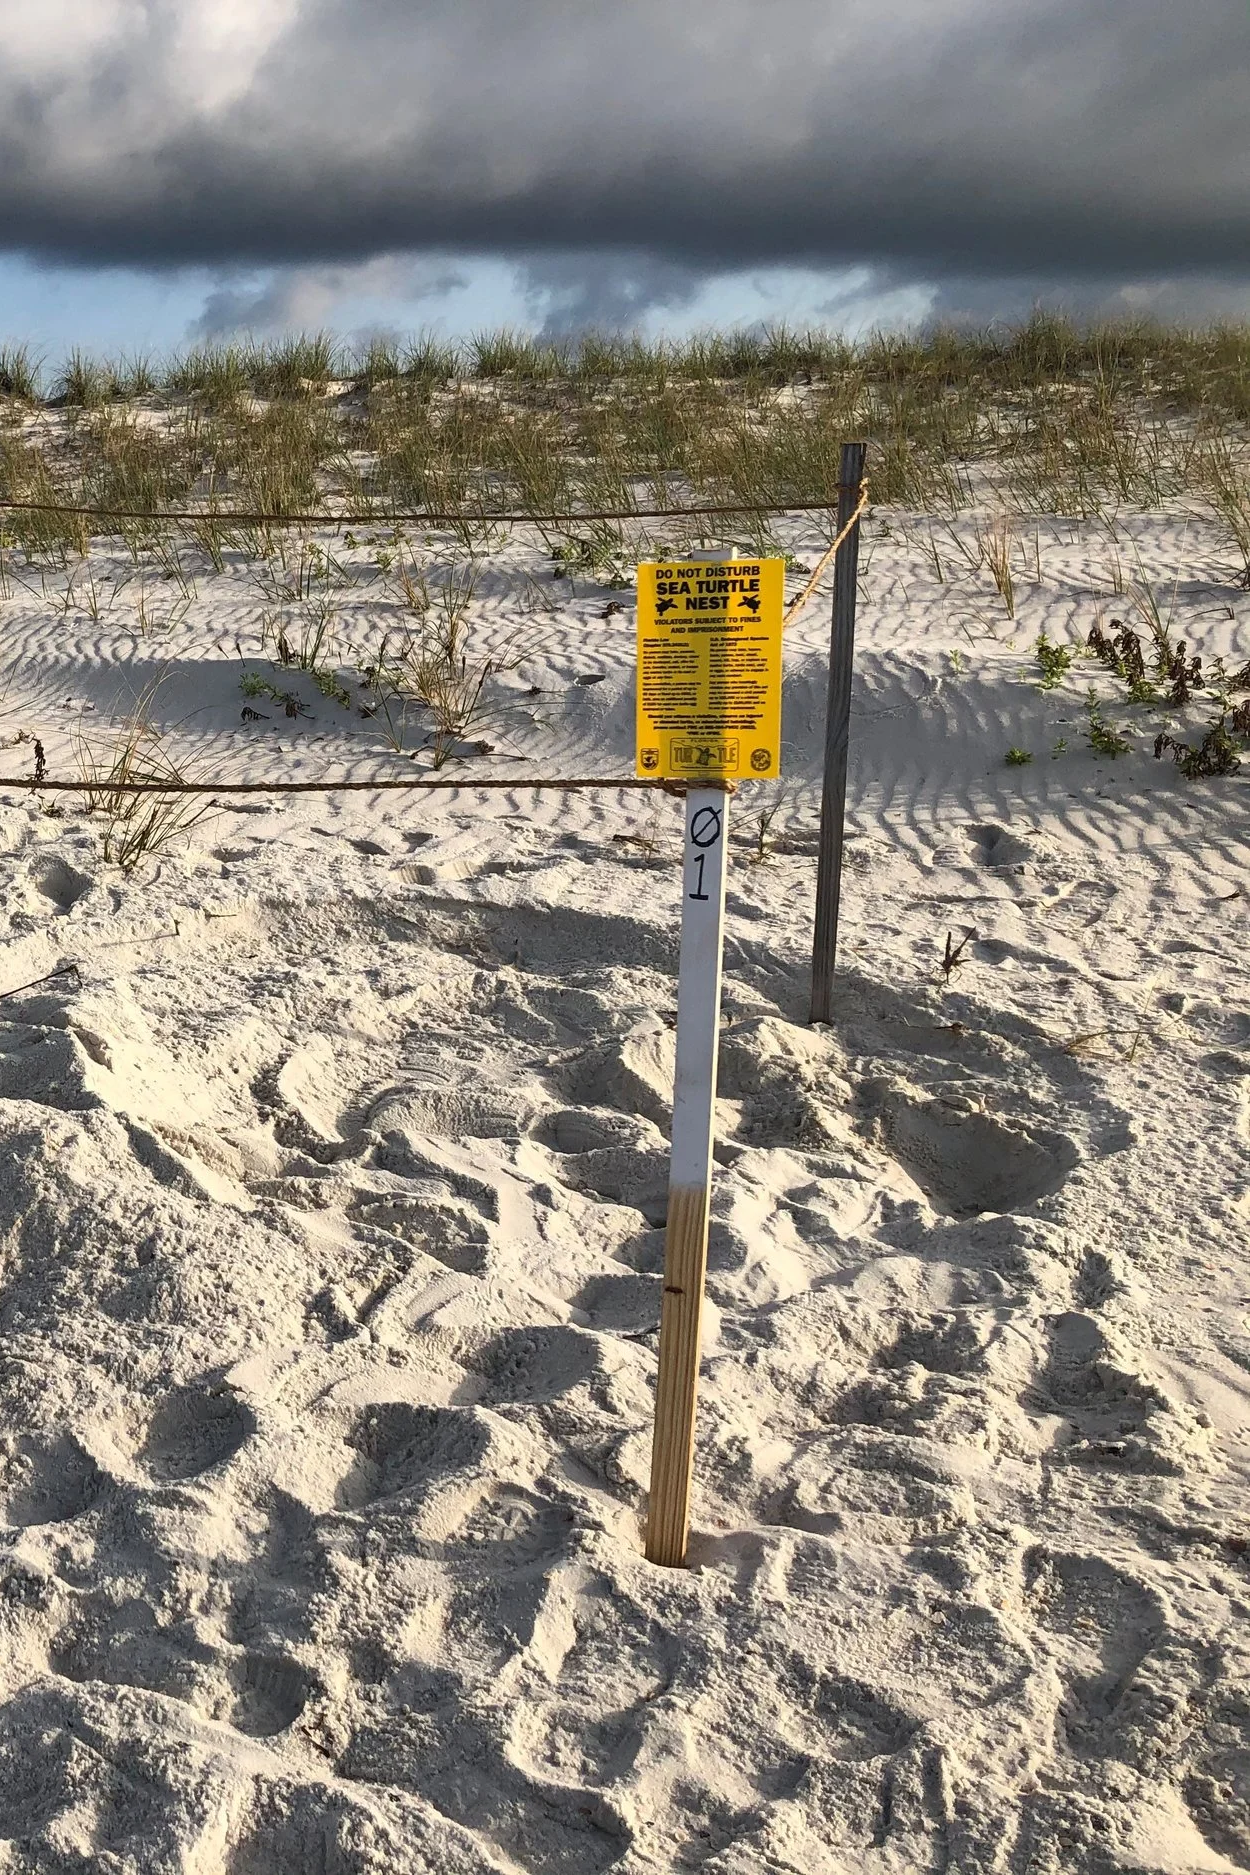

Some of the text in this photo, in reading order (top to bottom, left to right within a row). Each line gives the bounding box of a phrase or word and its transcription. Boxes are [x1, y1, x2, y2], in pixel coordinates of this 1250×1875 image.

[655, 565, 760, 580] DO NOT DISTURB
[656, 579, 760, 595] SEA TURTLE
[685, 595, 730, 611] NEST
[654, 615, 762, 626] VIOLATORS SUBJECT TO FINES
[687, 625, 744, 634] IMPRISONMENT
[717, 747, 737, 763] TLE
